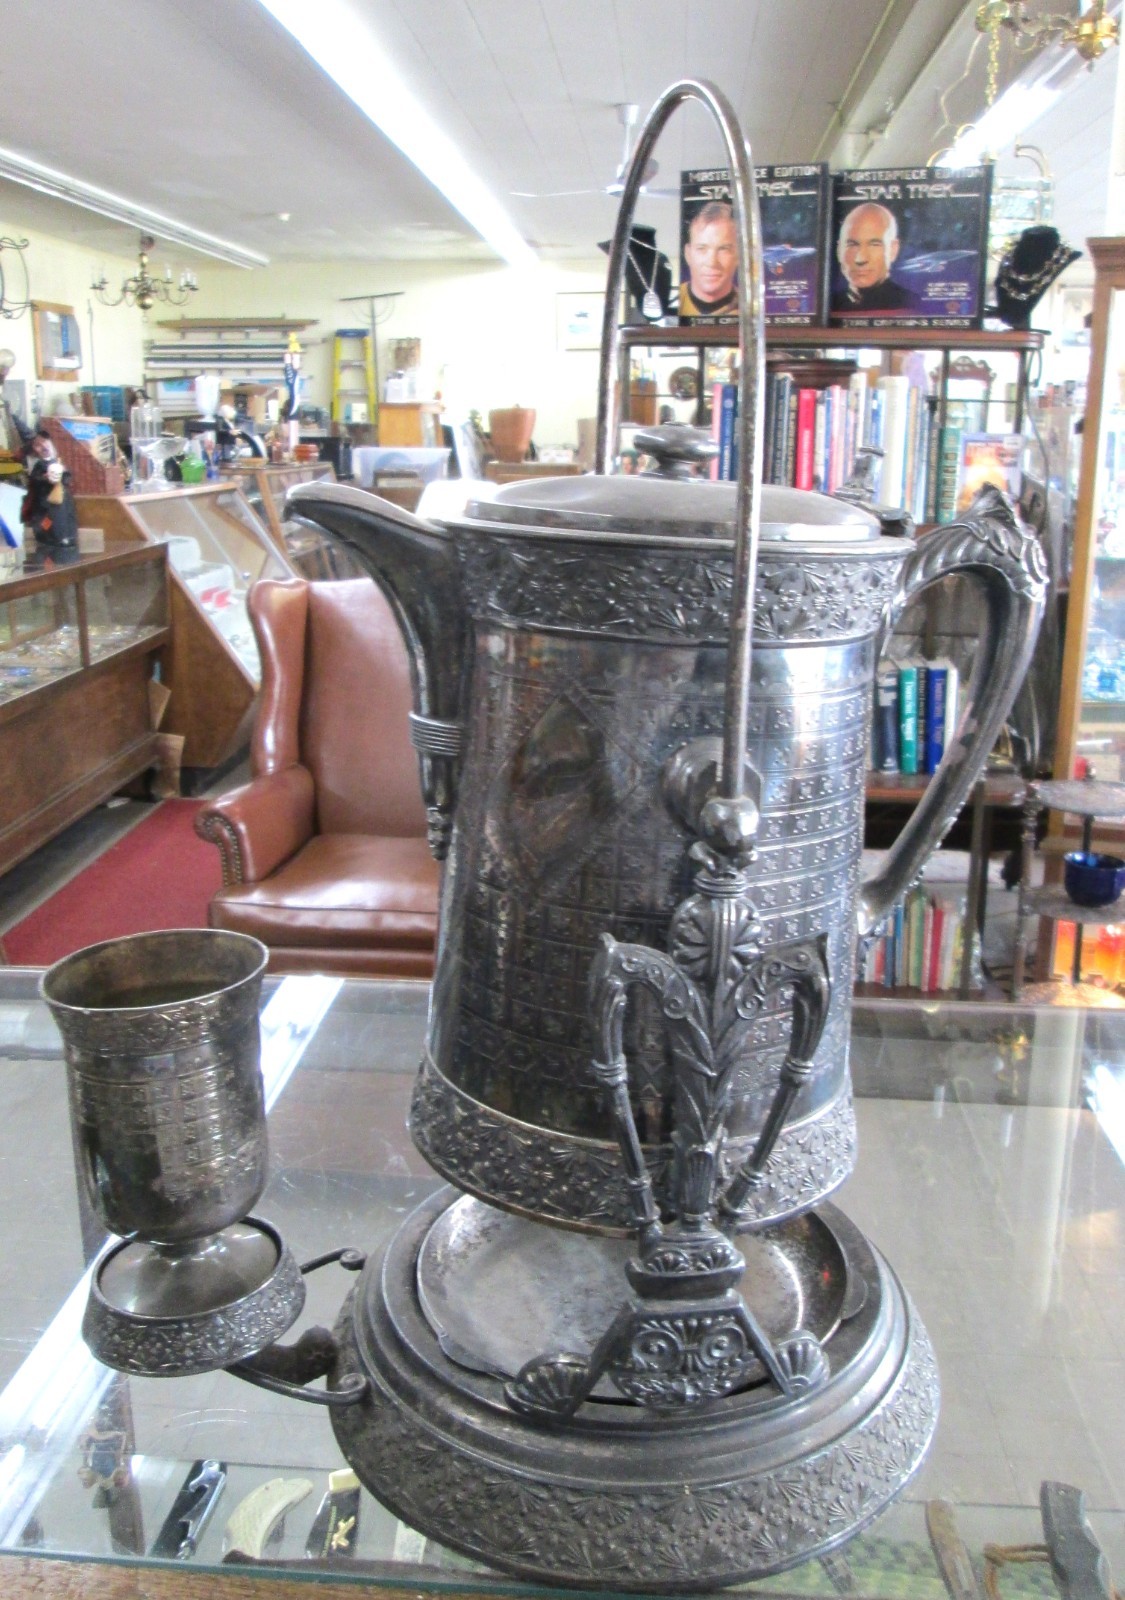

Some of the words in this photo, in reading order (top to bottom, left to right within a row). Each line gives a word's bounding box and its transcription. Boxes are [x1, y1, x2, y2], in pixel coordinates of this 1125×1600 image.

[689, 168, 768, 183] MASTECE
[848, 184, 902, 200] STAR
[906, 182, 962, 198] TREK
